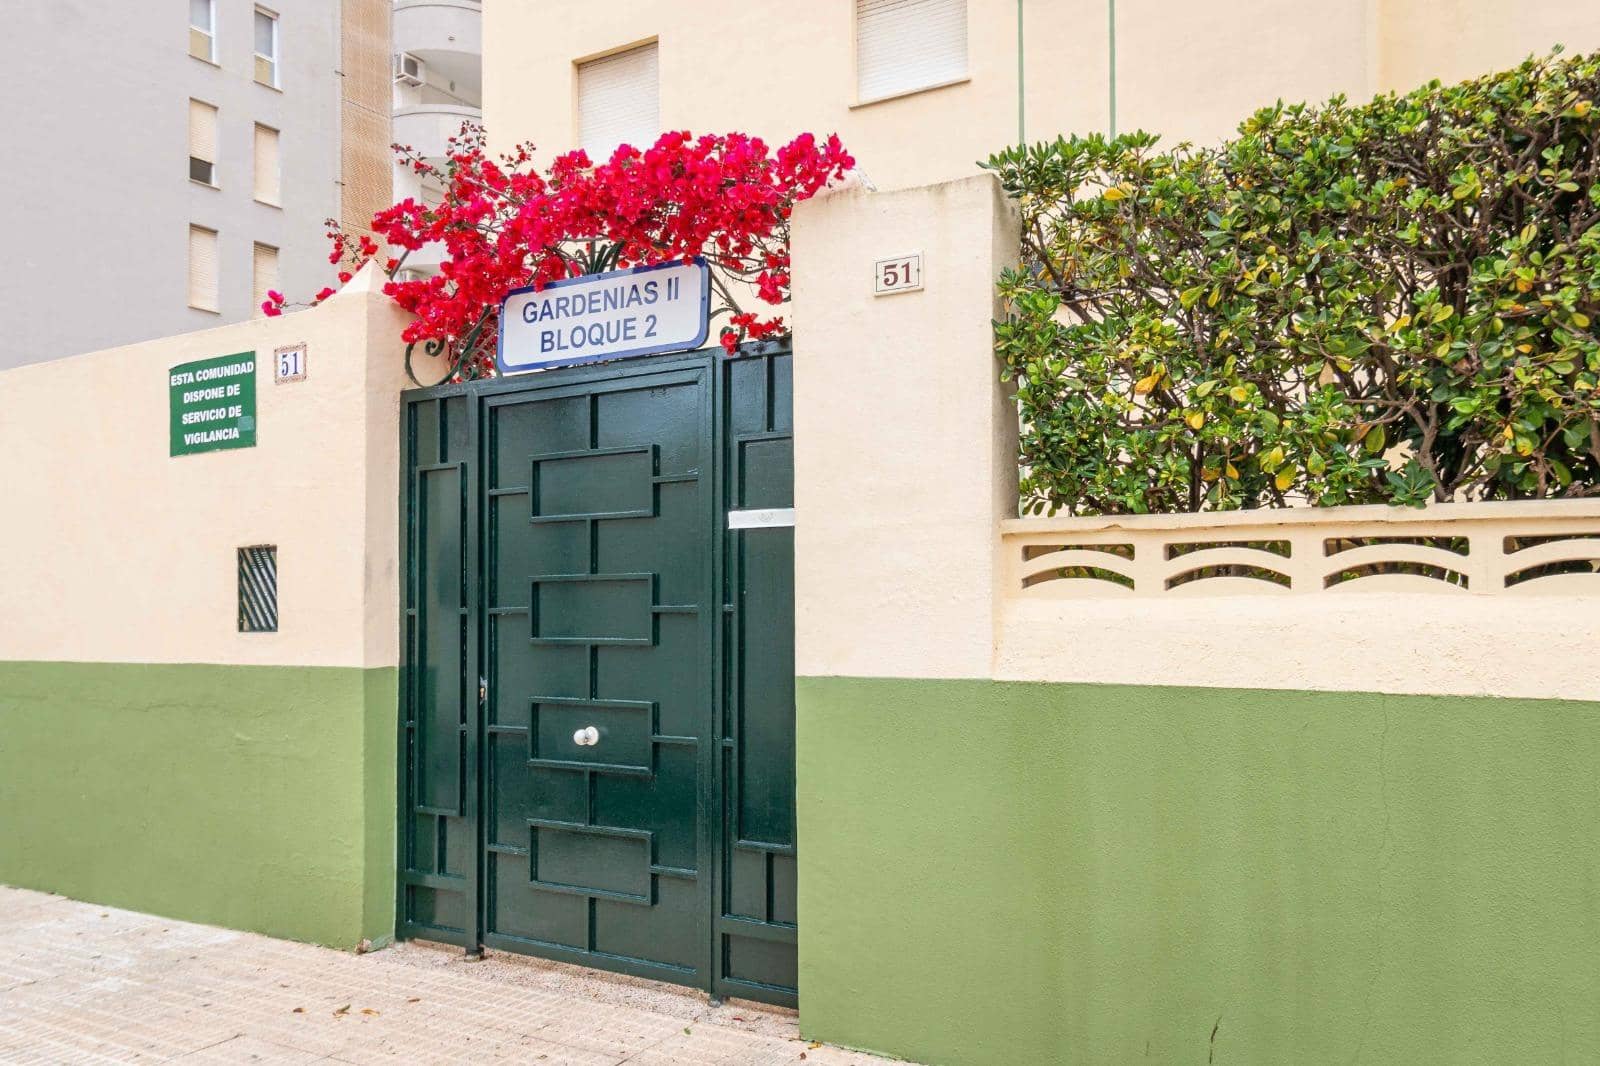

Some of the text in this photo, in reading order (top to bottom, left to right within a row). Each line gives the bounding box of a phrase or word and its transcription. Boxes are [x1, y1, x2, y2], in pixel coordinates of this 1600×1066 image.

[883, 261, 911, 287] 51
[522, 277, 680, 324] GARDENIAS II
[540, 314, 658, 353] BLOQUE 2
[170, 361, 254, 386] ESTA COMUNIDAD
[281, 352, 299, 377] 51
[183, 383, 241, 404] DISPONE DE
[181, 405, 242, 425] SERVICIO DE
[183, 427, 240, 446] VIGILANCIA
